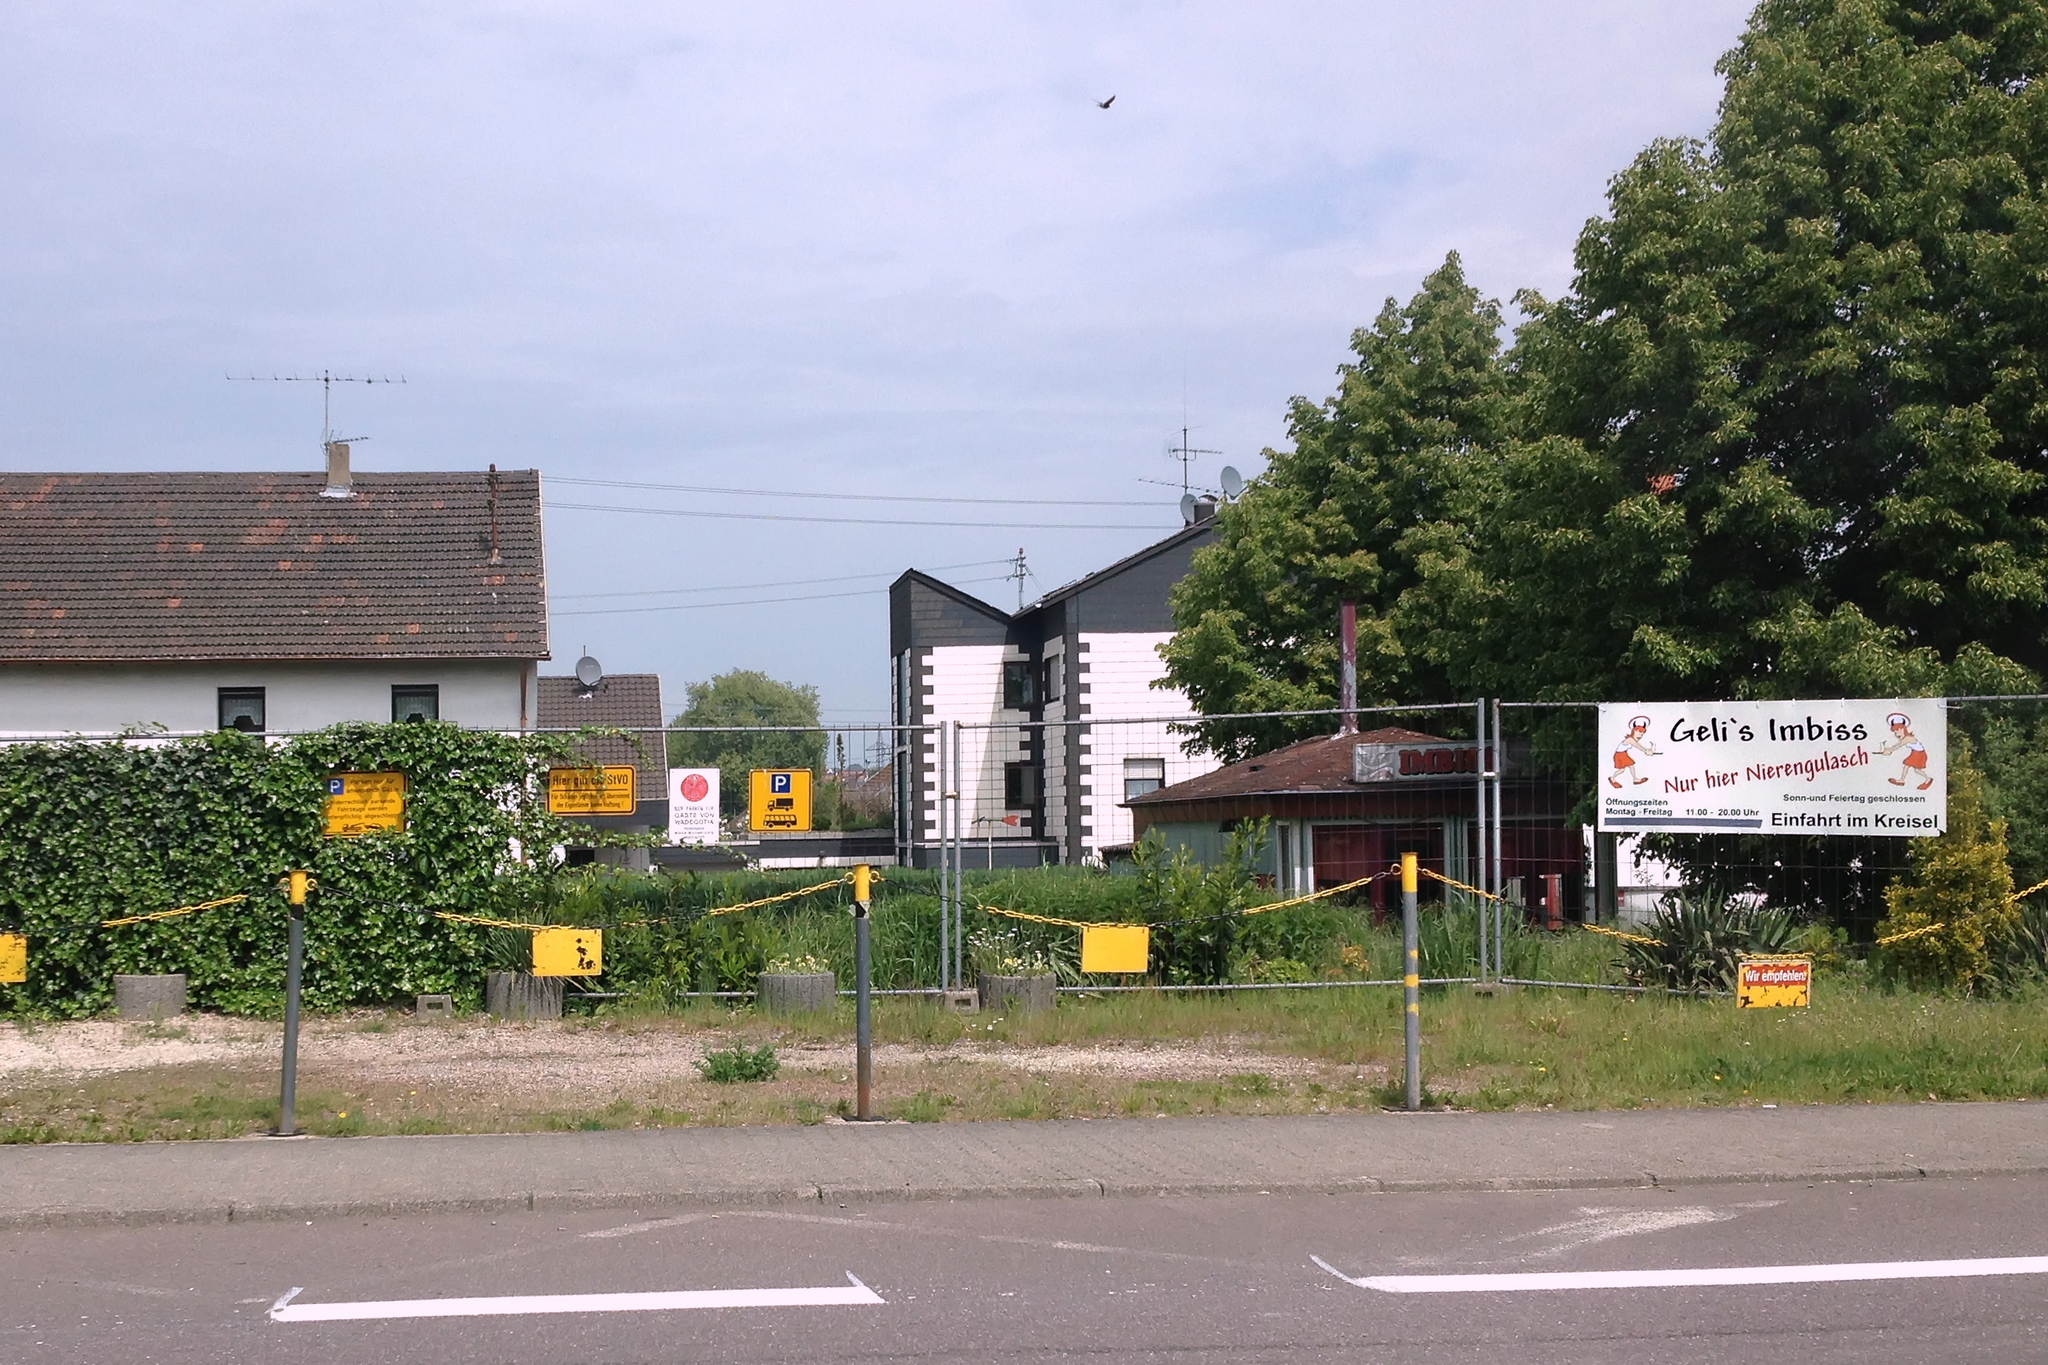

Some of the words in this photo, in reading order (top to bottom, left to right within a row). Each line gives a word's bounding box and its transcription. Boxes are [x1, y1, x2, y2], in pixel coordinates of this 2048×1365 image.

[1769, 716, 1868, 742] Imbiss
[1664, 776, 1699, 794] Nur
[1704, 769, 1739, 789] hier
[1746, 745, 1869, 782] Nierengulasch
[607, 773, 629, 785] StVO
[775, 775, 787, 792] P
[330, 779, 341, 793] P
[1605, 797, 1669, 808] Öffnungszeiten
[1783, 793, 1827, 802] Sonn-und
[1829, 793, 1866, 804] Feiertag
[1867, 794, 1926, 804] geschlossen
[1605, 807, 1637, 817] Montag
[1643, 807, 1673, 817] Freitag
[1717, 808, 1741, 816] 20.00
[1743, 808, 1760, 816] Uhr
[1771, 812, 1842, 827] Einfahrt
[1847, 813, 1868, 828] im
[1874, 813, 1939, 829] Kreisel
[1745, 969, 1760, 982] Wir
